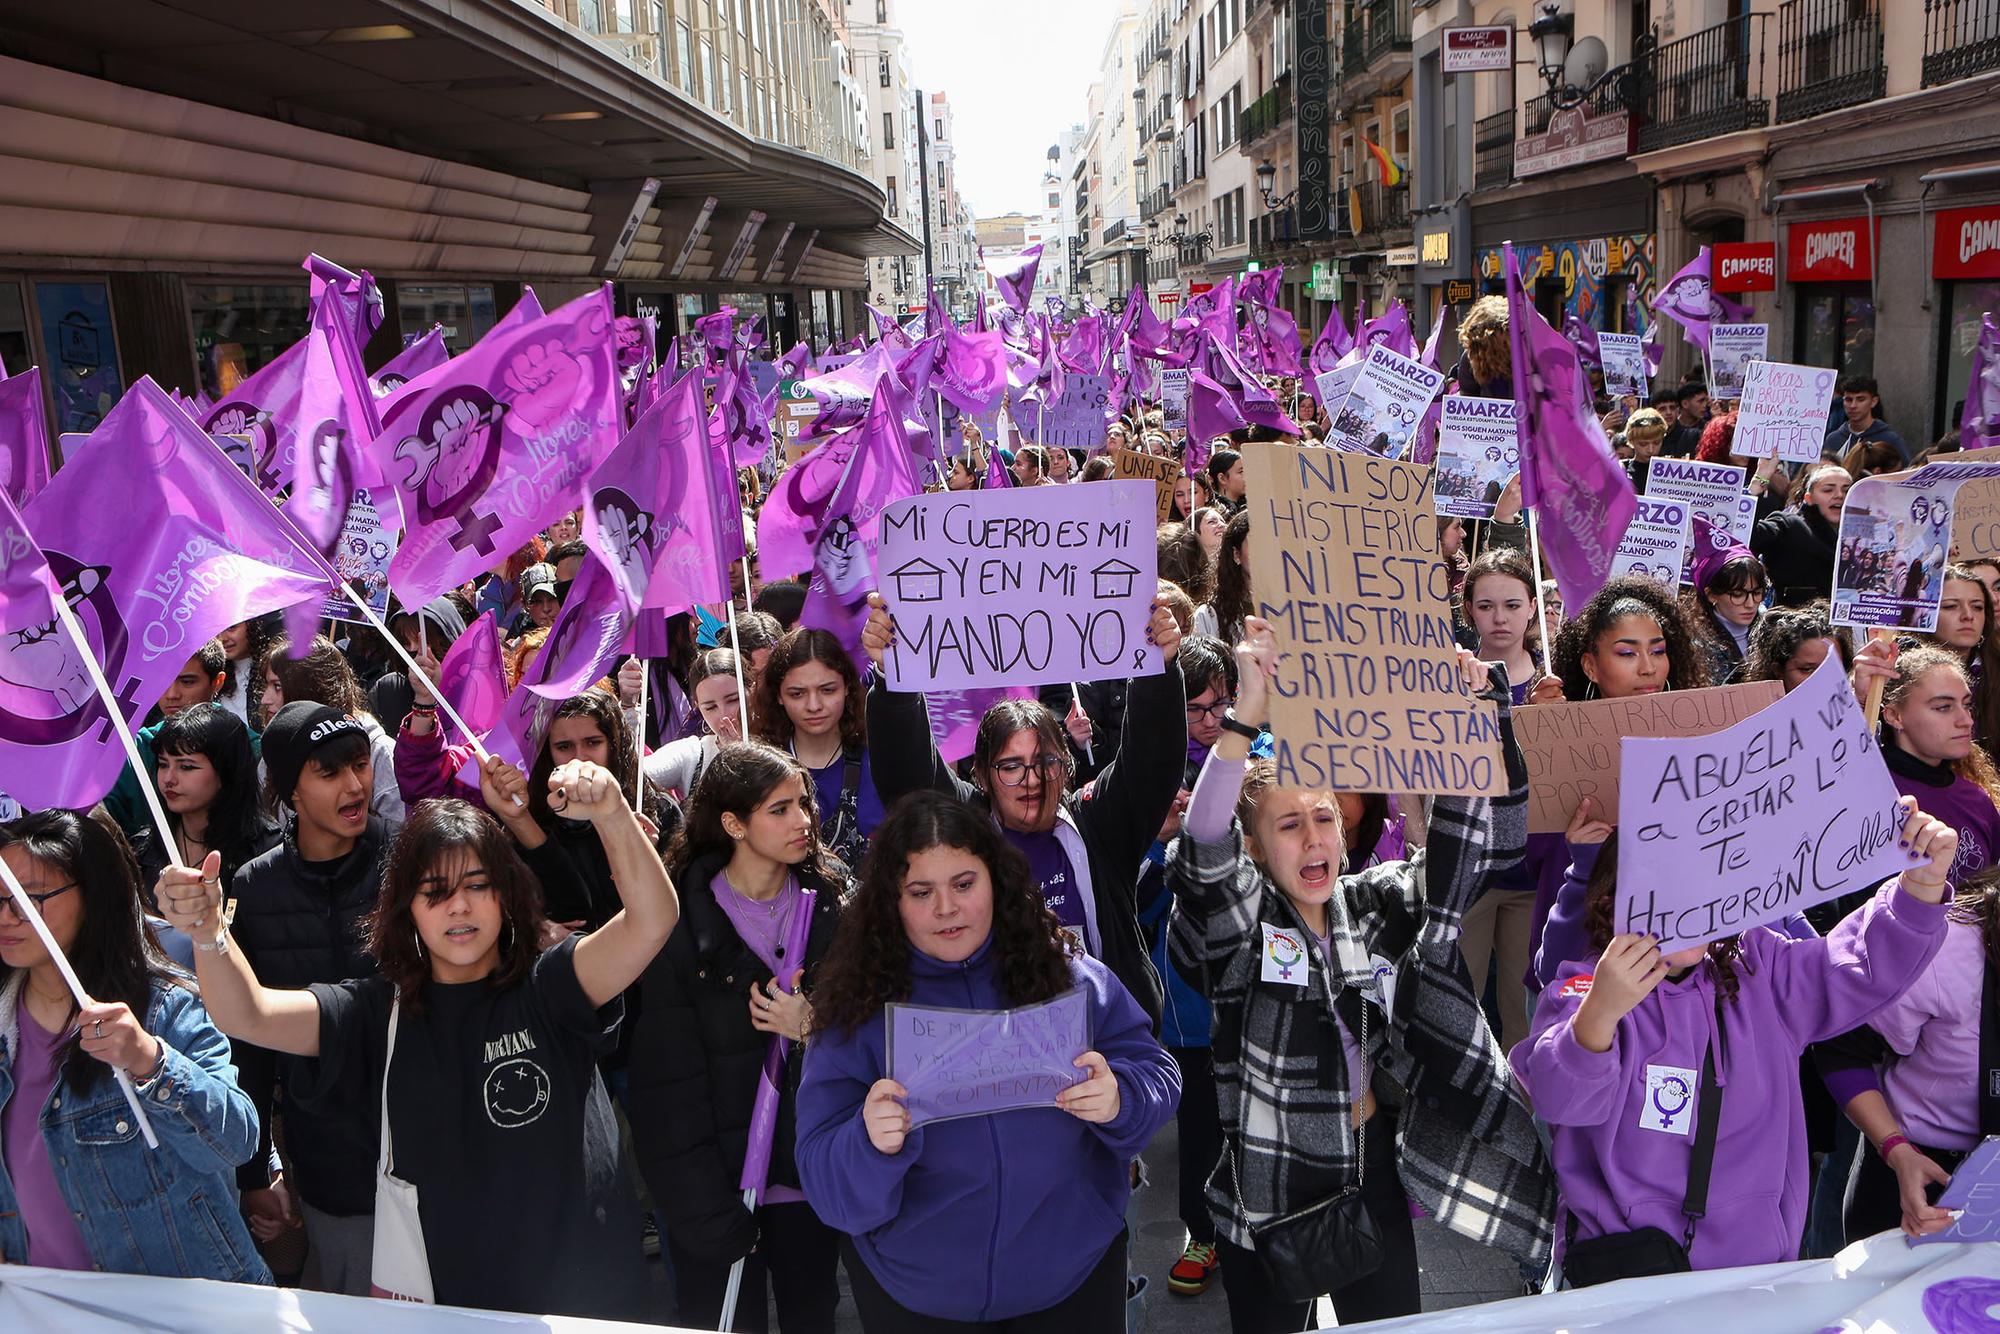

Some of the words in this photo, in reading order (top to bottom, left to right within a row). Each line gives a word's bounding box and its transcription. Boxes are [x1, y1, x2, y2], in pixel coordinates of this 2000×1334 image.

[1805, 230, 1856, 270] CAMPER
[1959, 219, 2000, 264] CAM
[1722, 256, 1774, 278] CAMPER
[1600, 334, 1638, 345] 8MARZO
[1715, 326, 1764, 336] 8MARZO
[1163, 371, 1187, 380] 8MAR
[1372, 350, 1437, 387] 8MARZO
[1364, 370, 1378, 381] NOS
[1378, 376, 1399, 391] SIGUEN
[1399, 386, 1426, 402] MATANDO
[1758, 387, 1799, 404] BRUJAS
[1467, 416, 1498, 425] ESTUDIANTIL
[1488, 427, 1517, 436] MATAND
[1737, 426, 1822, 459] MUJERES
[1122, 455, 1154, 479] UNA
[1156, 462, 1176, 485] SE
[1366, 461, 1431, 505] SOY
[1652, 462, 1740, 486] 8MARZO
[1652, 477, 1674, 485] HUELGA
[1674, 480, 1708, 489] ESTUDIANTIL
[1708, 484, 1737, 492] FEMINISTA
[1668, 488, 1696, 498] SIGUEN
[1696, 492, 1734, 503] MATANDO
[355, 516, 381, 527] MATAN
[943, 503, 1051, 549] CUERPO
[1057, 521, 1089, 548] ES
[1634, 501, 1683, 526] RZO
[345, 525, 373, 535] LANDO
[1634, 536, 1677, 549] MATANDO
[1648, 524, 1681, 535] FEMINISTA
[1616, 545, 1654, 557] OLANDO
[947, 557, 969, 598] Y
[979, 559, 1022, 595] EN
[1353, 551, 1450, 603] ESTO
[1260, 600, 1456, 649] MENSTRUAN
[889, 609, 1053, 683] MANDO
[1066, 609, 1126, 669] YO
[1385, 654, 1468, 697] PORQU
[1314, 708, 1392, 741] NOS
[1406, 702, 1502, 745] ESTÁN
[1569, 743, 1611, 773] NO
[1651, 718, 1804, 804] ABUELA
[1696, 774, 1796, 836] GRITAR
[912, 1016, 937, 1037] DE
[978, 1001, 1078, 1047] CUERPO
